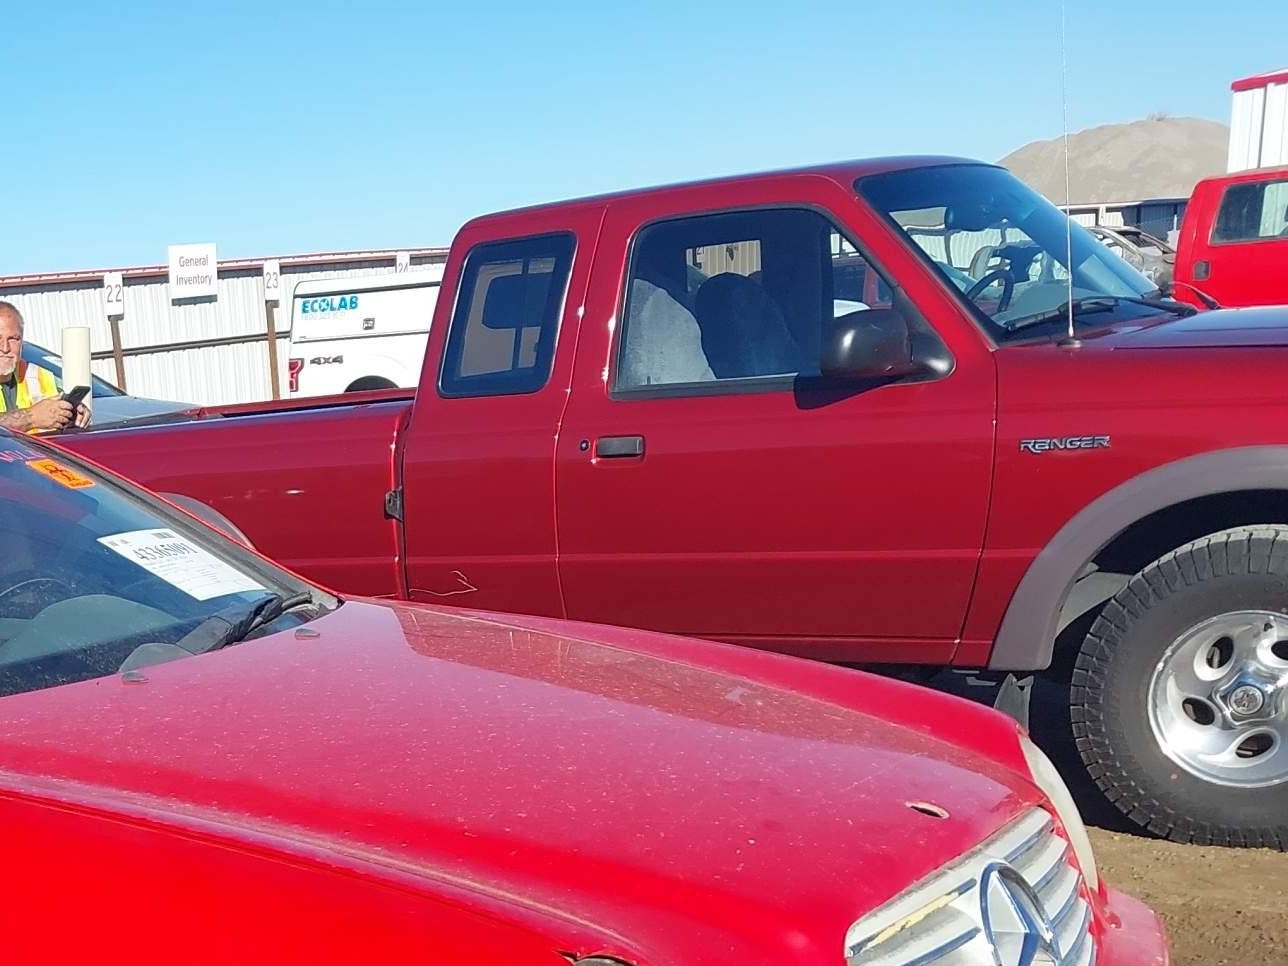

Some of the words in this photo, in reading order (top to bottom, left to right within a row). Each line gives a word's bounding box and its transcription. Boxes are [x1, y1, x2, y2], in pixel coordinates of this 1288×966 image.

[178, 254, 209, 267] General
[176, 273, 213, 287] Inventory
[265, 271, 279, 289] 23
[105, 284, 123, 303] 22
[301, 295, 359, 314] ECOLAB
[1019, 435, 1111, 454] RANGER
